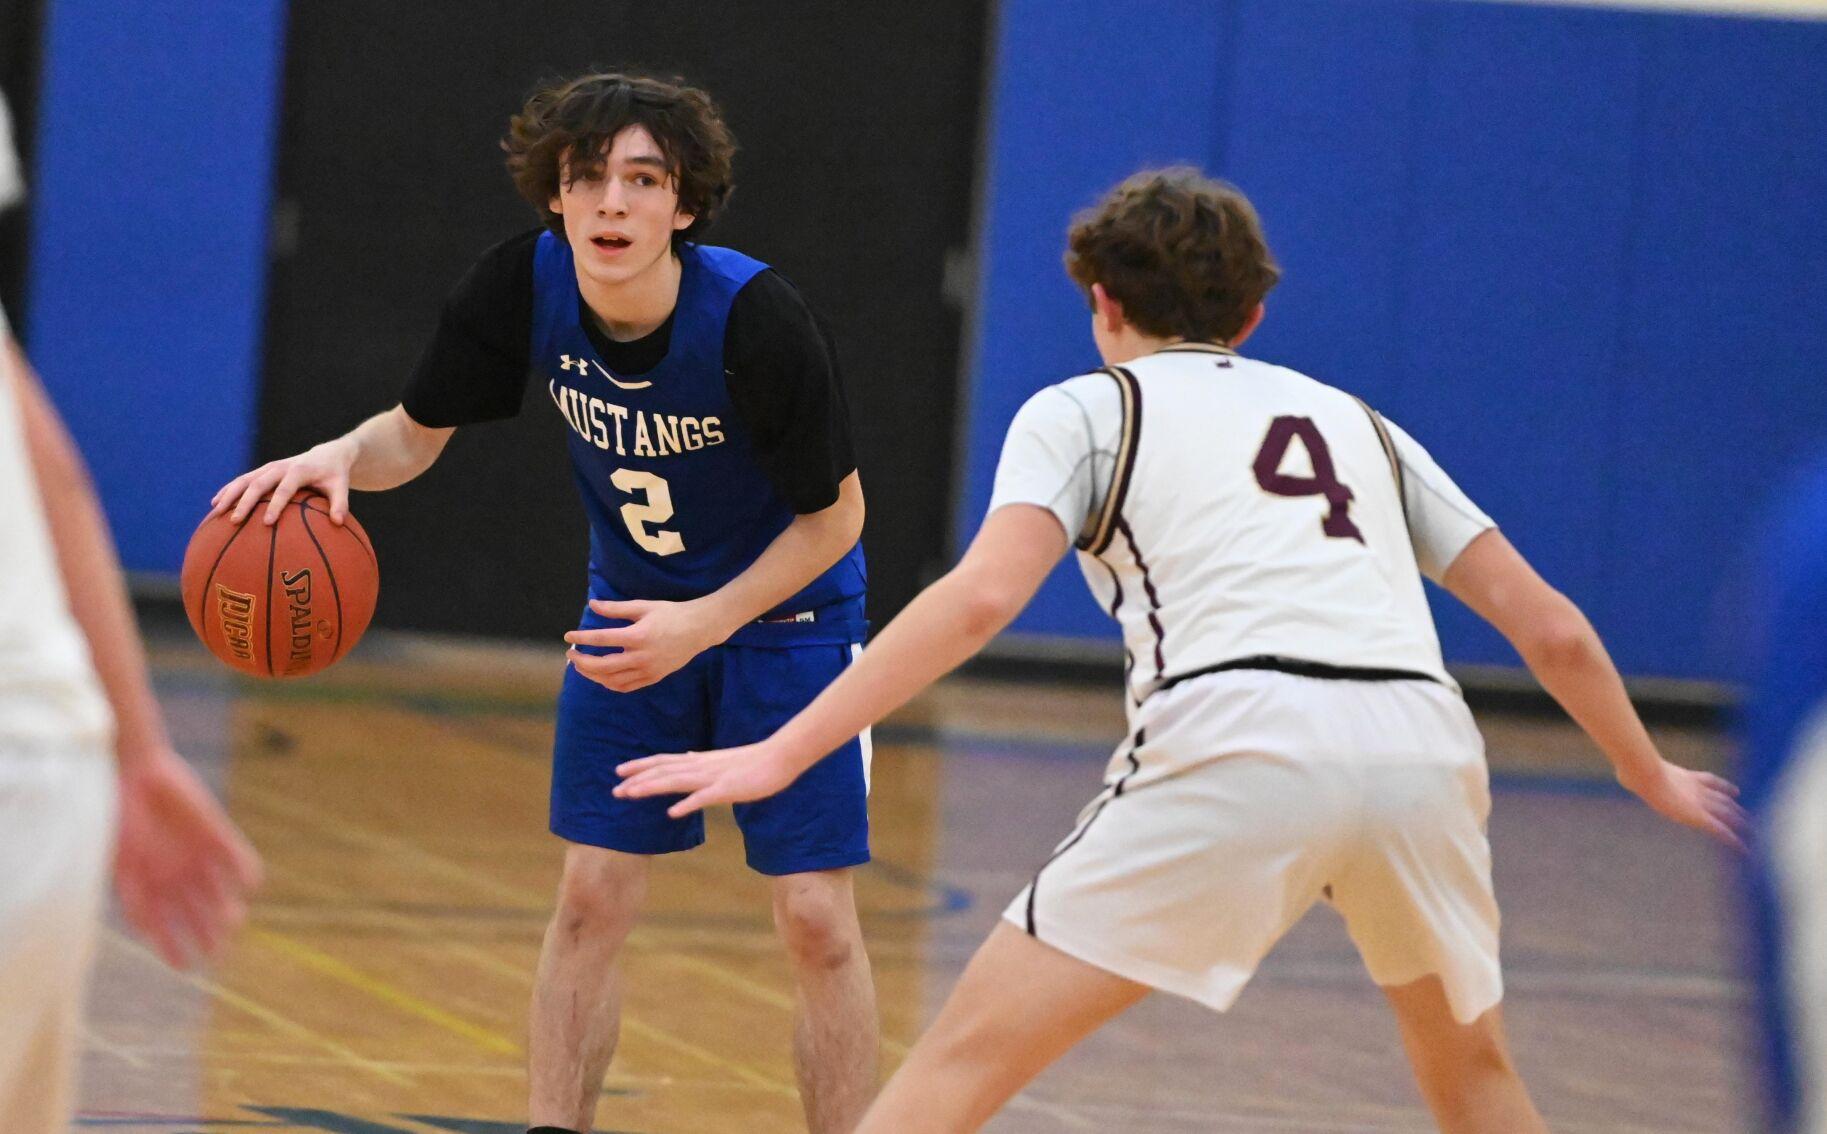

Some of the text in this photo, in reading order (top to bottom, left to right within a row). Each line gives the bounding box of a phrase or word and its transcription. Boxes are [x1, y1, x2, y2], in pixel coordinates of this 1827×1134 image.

[549, 378, 725, 457] MUSTANGS
[609, 467, 686, 557] 2
[1252, 414, 1366, 546] 4
